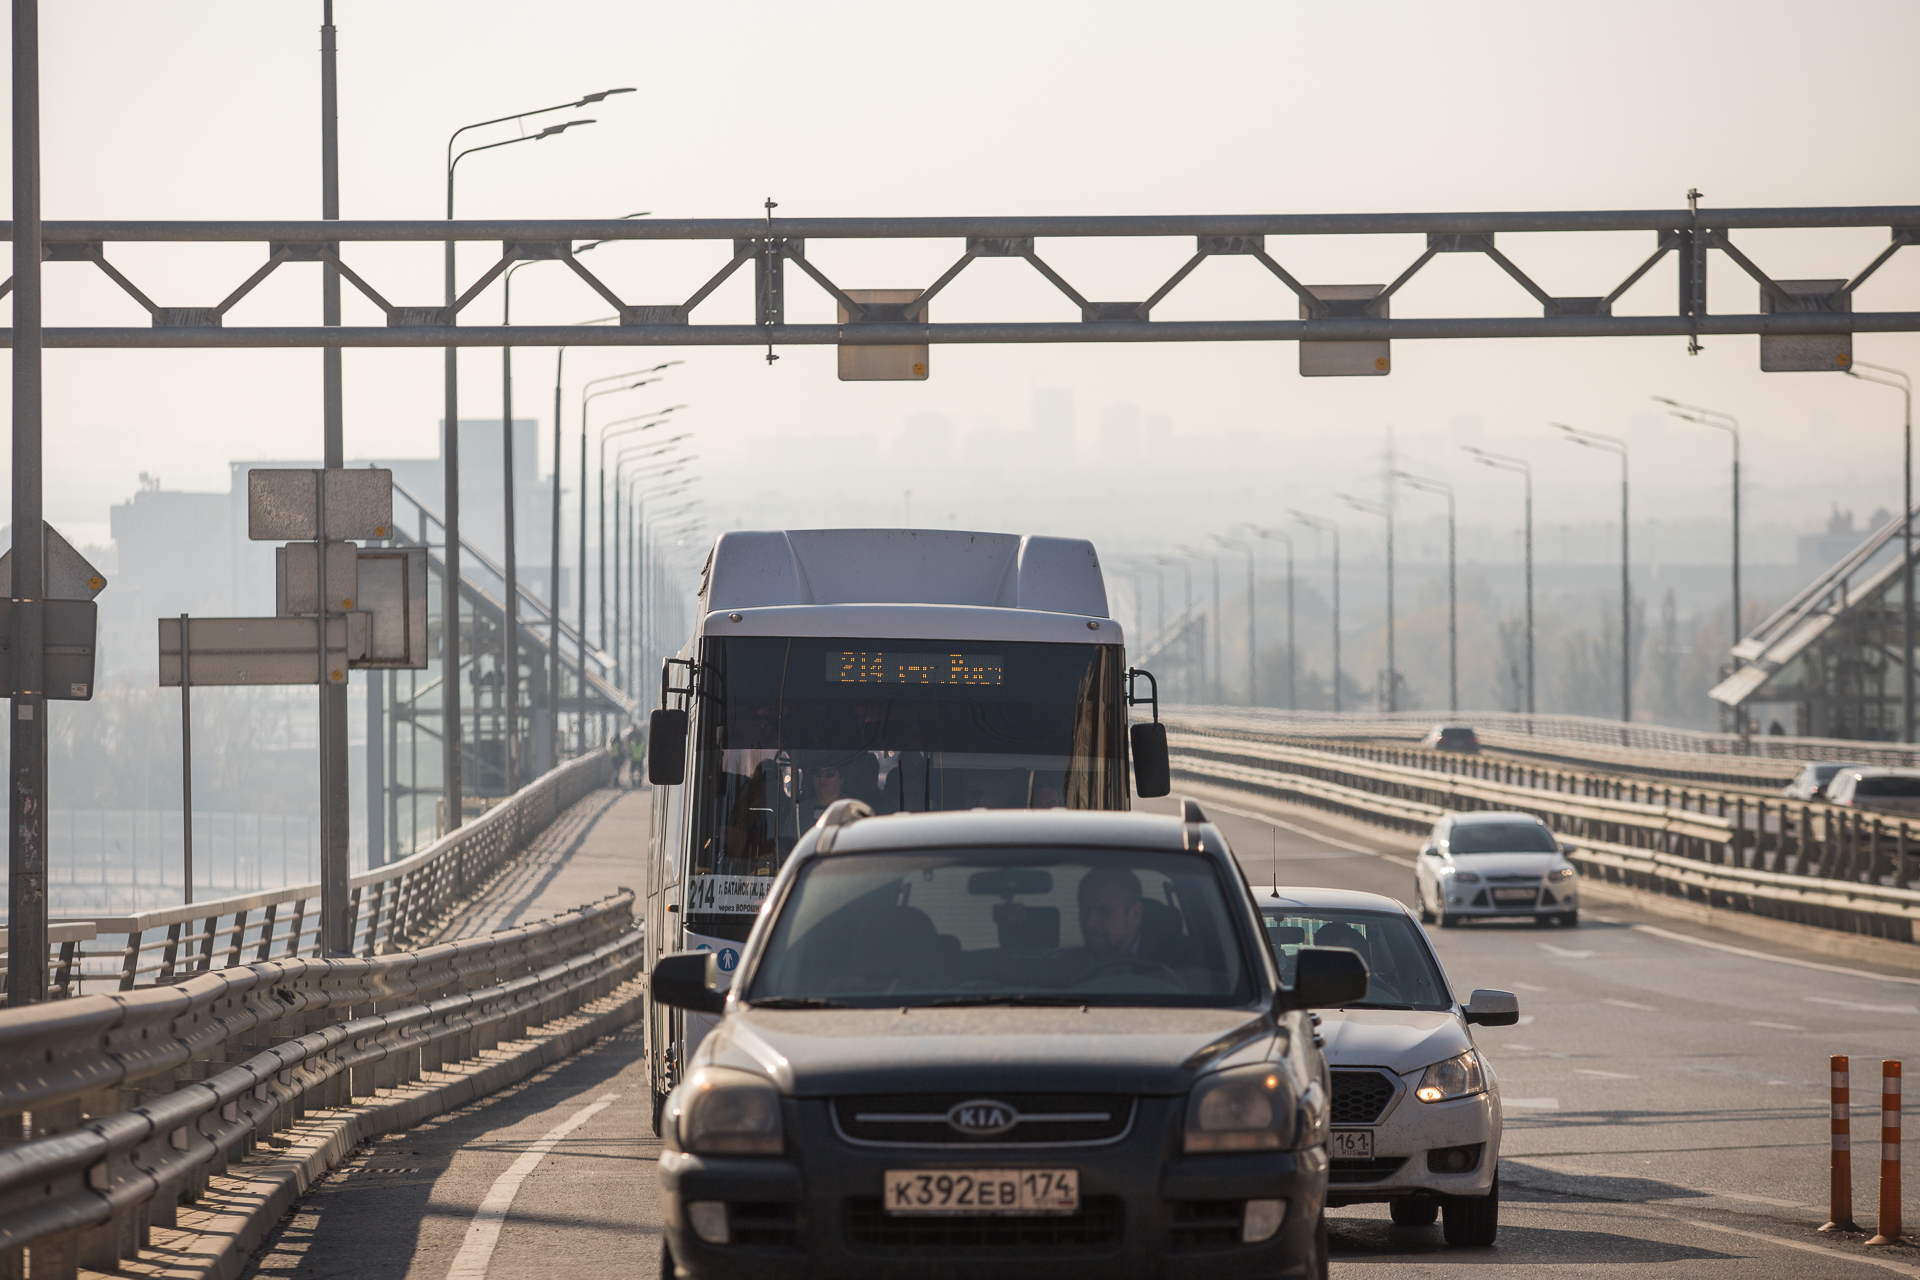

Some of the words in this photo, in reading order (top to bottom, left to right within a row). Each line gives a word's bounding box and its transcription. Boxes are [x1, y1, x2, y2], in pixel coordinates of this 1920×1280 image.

[841, 652, 884, 683] 214
[689, 879, 715, 909] 214
[724, 879, 749, 896] БАТАЙСК
[719, 905, 734, 913] через
[736, 904, 761, 912] ВОРОШИ
[960, 1108, 1005, 1126] KIA
[1336, 1134, 1366, 1149] 161
[1024, 1173, 1070, 1198] 174
